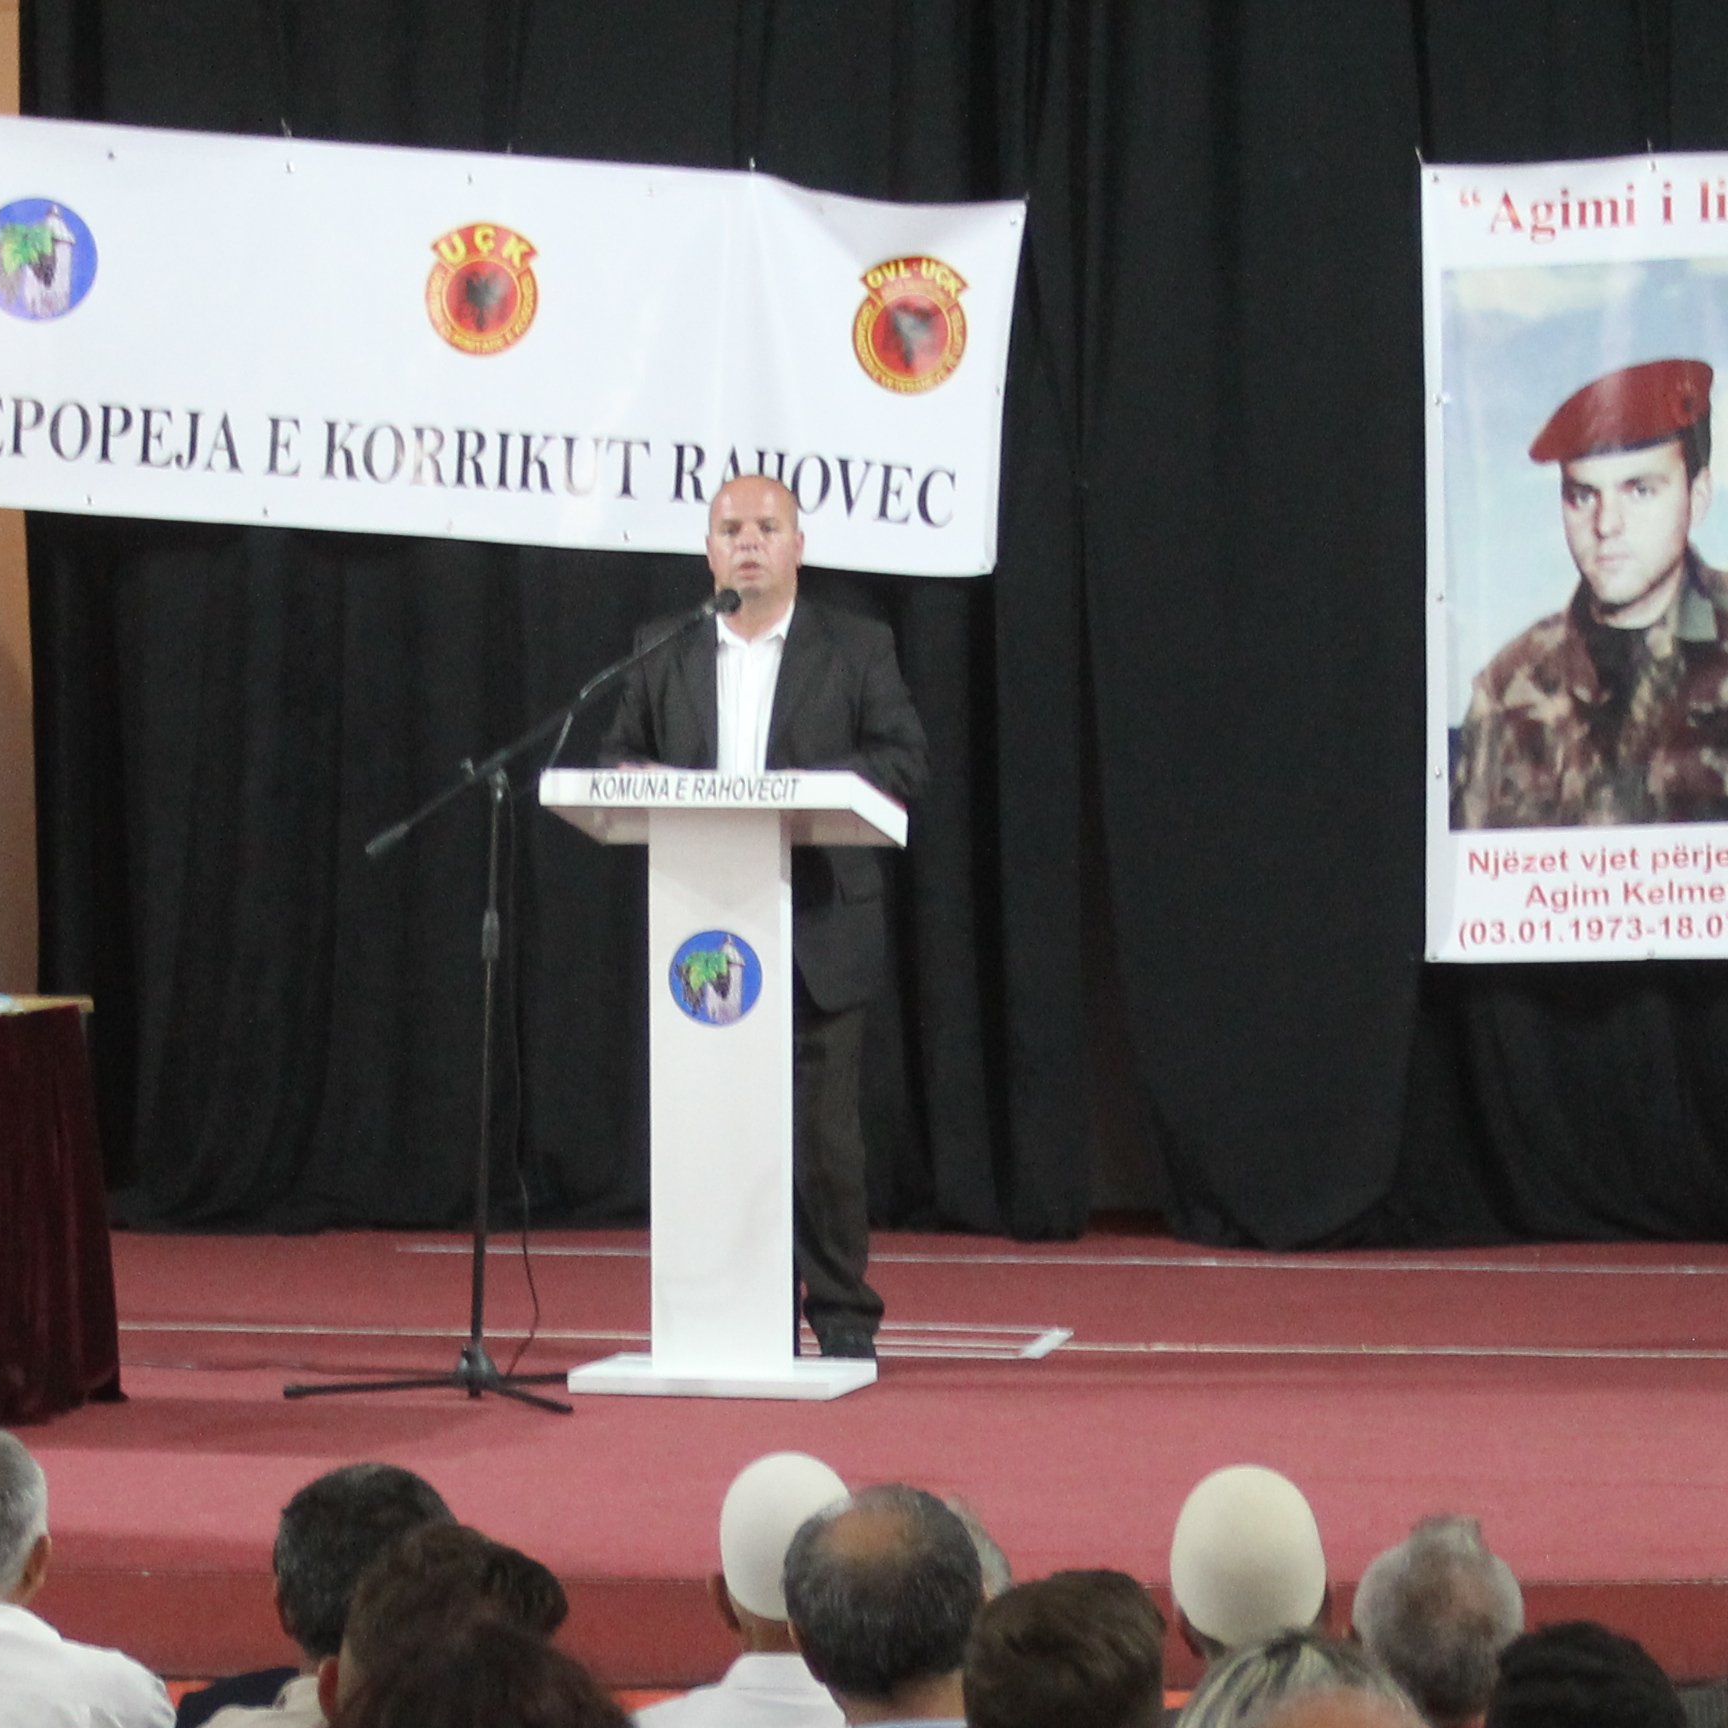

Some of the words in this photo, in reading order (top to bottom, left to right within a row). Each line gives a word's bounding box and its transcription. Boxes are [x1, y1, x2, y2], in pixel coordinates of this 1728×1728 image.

[1661, 181, 1673, 223] i
[266, 416, 301, 478] E
[323, 421, 651, 499] KORRIKUT
[589, 771, 671, 801] KOMUNA
[674, 774, 689, 800] E
[692, 775, 800, 801] RAHOVECIT
[1468, 849, 1569, 881] Njëzet
[1581, 845, 1639, 873] vjet
[1525, 884, 1611, 913] Agim
